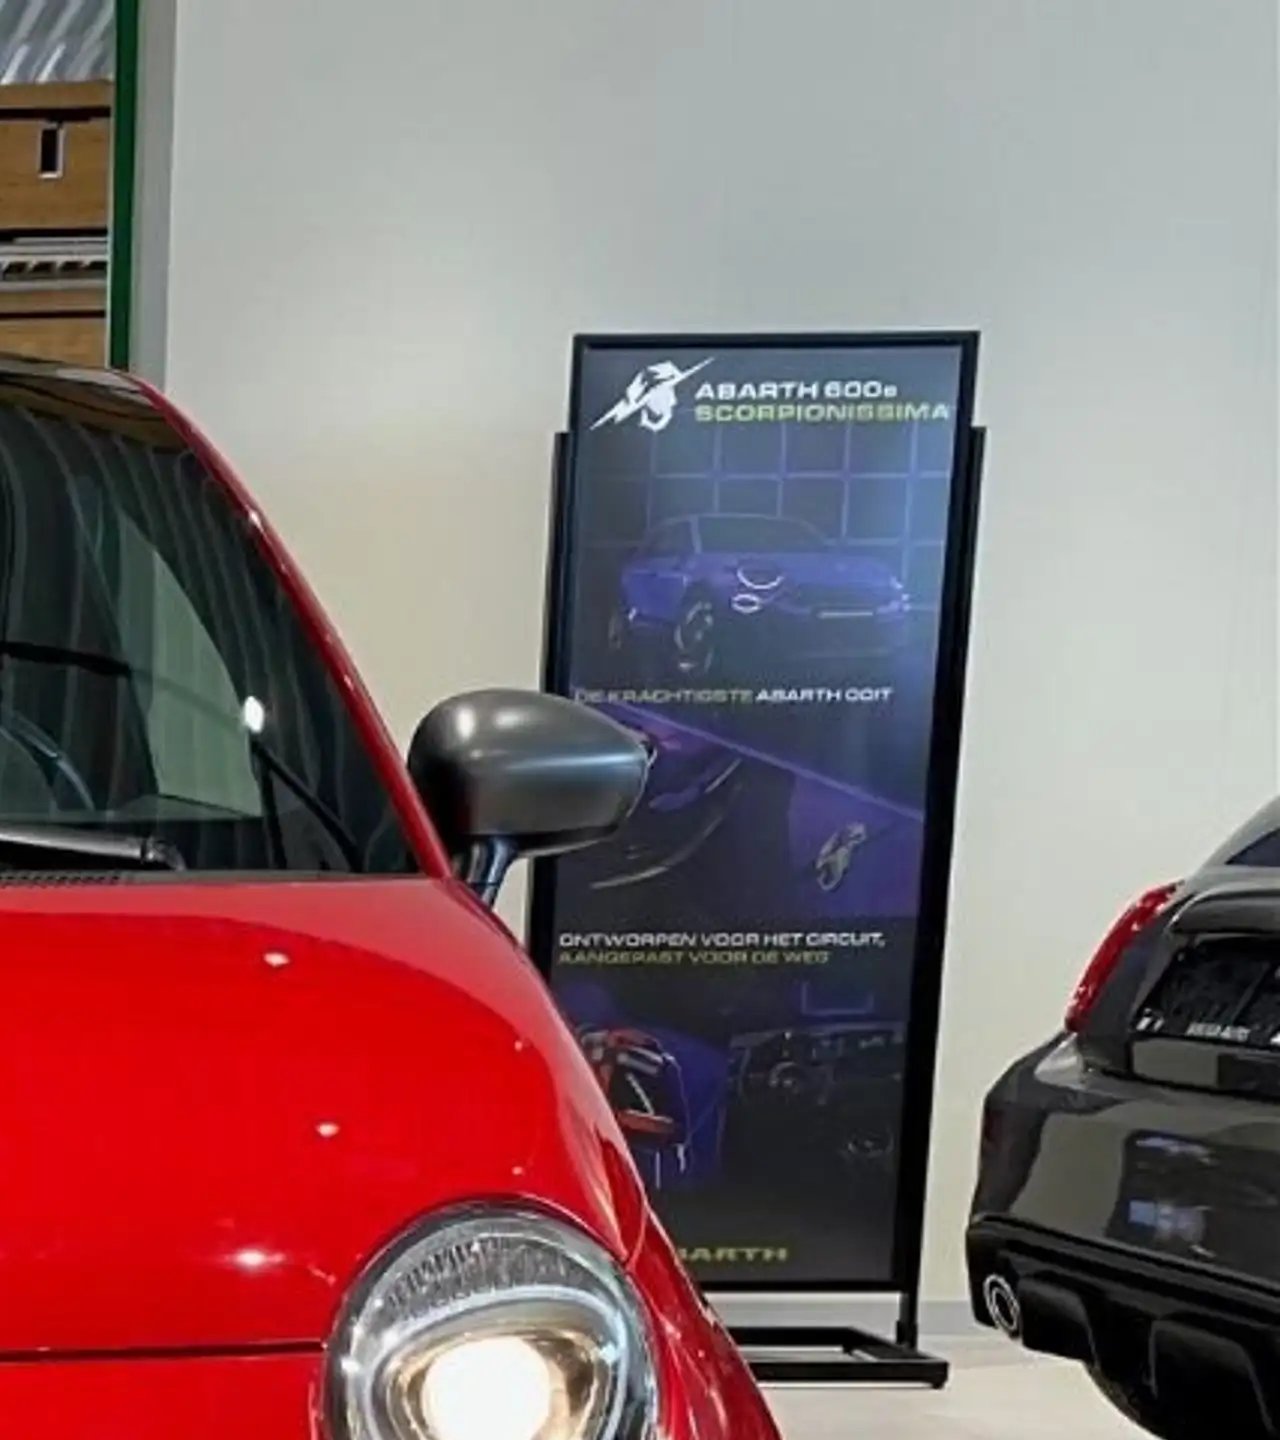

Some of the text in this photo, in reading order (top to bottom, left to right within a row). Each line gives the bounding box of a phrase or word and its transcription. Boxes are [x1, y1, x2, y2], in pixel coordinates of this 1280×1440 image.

[694, 382, 819, 400] ABARTH
[694, 403, 950, 423] SCORPIONISSIMA
[755, 687, 840, 702] ABARTH
[559, 932, 696, 948] ONTWORPEN
[700, 932, 759, 948] VOOR
[763, 932, 803, 947] HET
[557, 950, 830, 965] AANGEPAST VOOR DE WEG
[678, 1247, 788, 1263] ARTH
